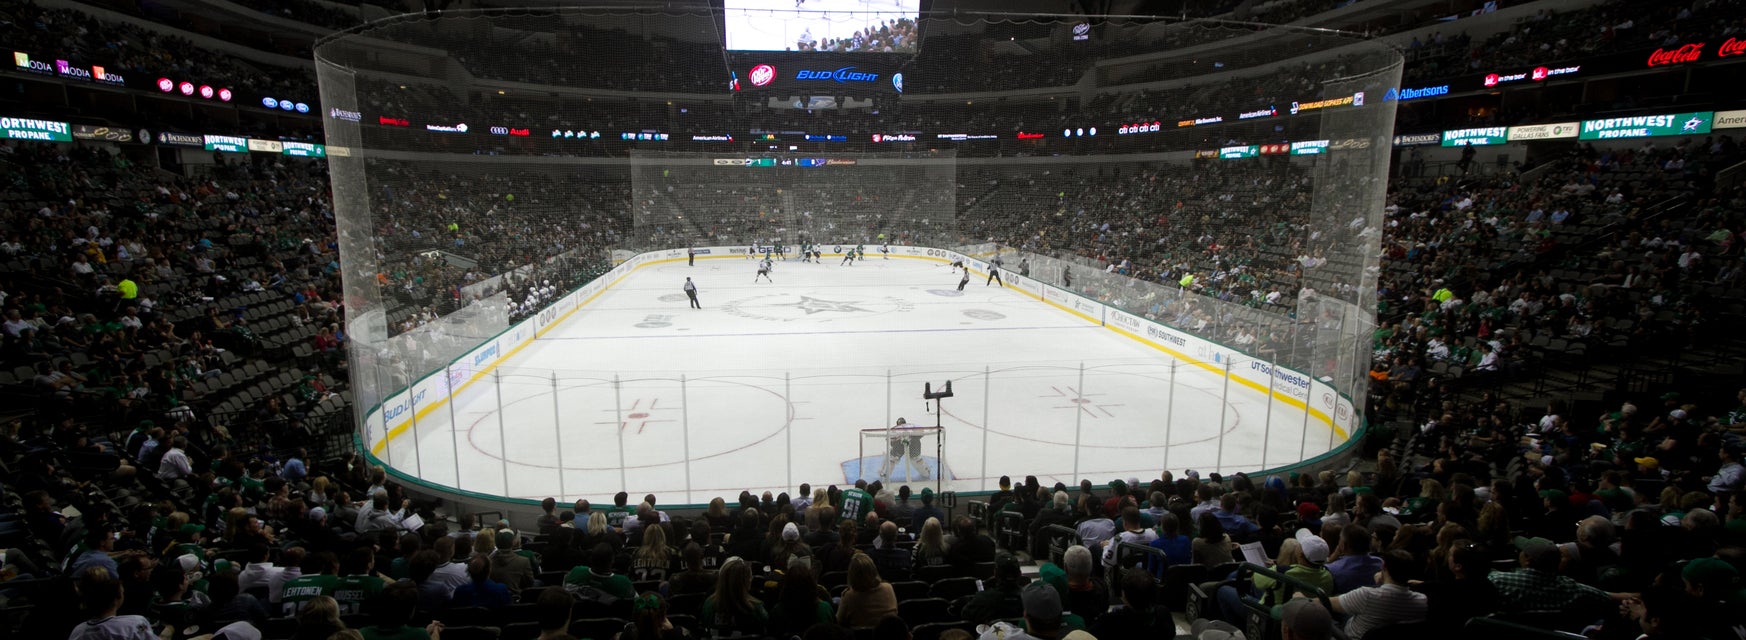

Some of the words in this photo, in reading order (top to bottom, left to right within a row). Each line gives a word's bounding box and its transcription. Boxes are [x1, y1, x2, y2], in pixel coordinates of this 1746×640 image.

[796, 70, 833, 80] BUD
[839, 71, 879, 82] LIGHT
[1399, 85, 1449, 100] Albertsons
[1584, 115, 1676, 133] NORTHWEST
[1717, 116, 1746, 126] Amer
[8, 129, 51, 140] PROPANE
[510, 128, 530, 136] Audi
[1444, 127, 1507, 141] NORTHWEST
[1517, 126, 1547, 134] POWERING
[1598, 128, 1647, 138] PROPANE
[203, 134, 246, 147] NORTHWEST
[283, 141, 314, 152] NORTHWEST
[1251, 360, 1261, 371] UT
[384, 404, 403, 424] BUD
[283, 586, 323, 598] LEHTONEN
